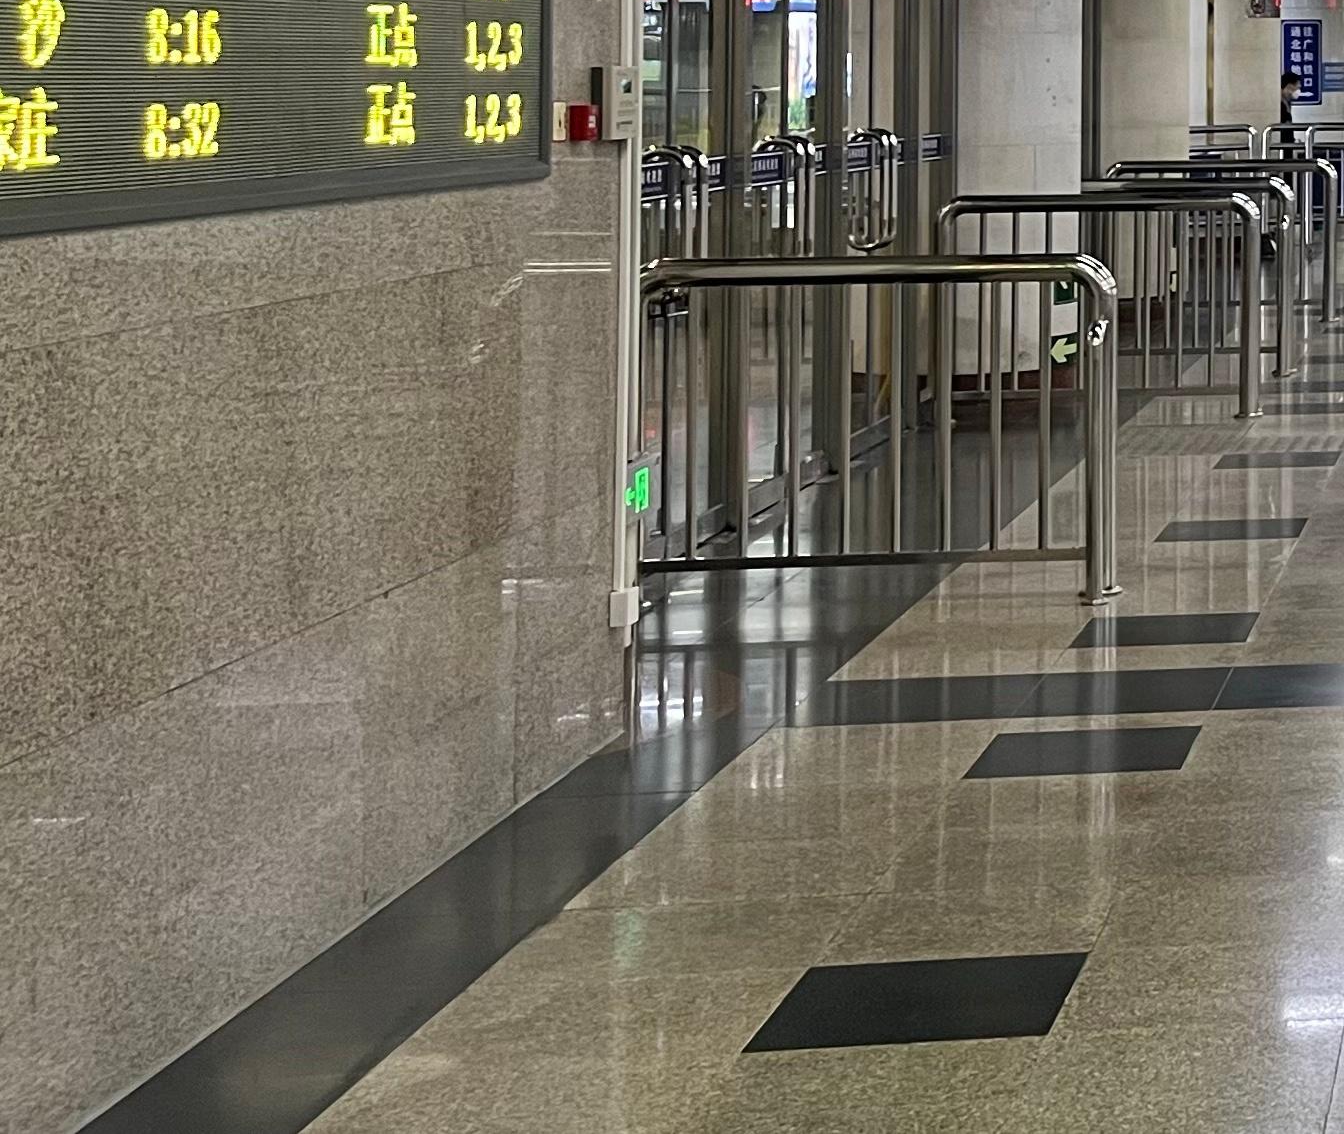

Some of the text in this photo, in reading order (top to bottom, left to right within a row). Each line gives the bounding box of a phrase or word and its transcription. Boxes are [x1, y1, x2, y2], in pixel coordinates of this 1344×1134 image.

[143, 8, 222, 68] 8:16
[364, 2, 418, 68] 正点
[140, 102, 220, 160] 8:32
[363, 82, 416, 147] 正点
